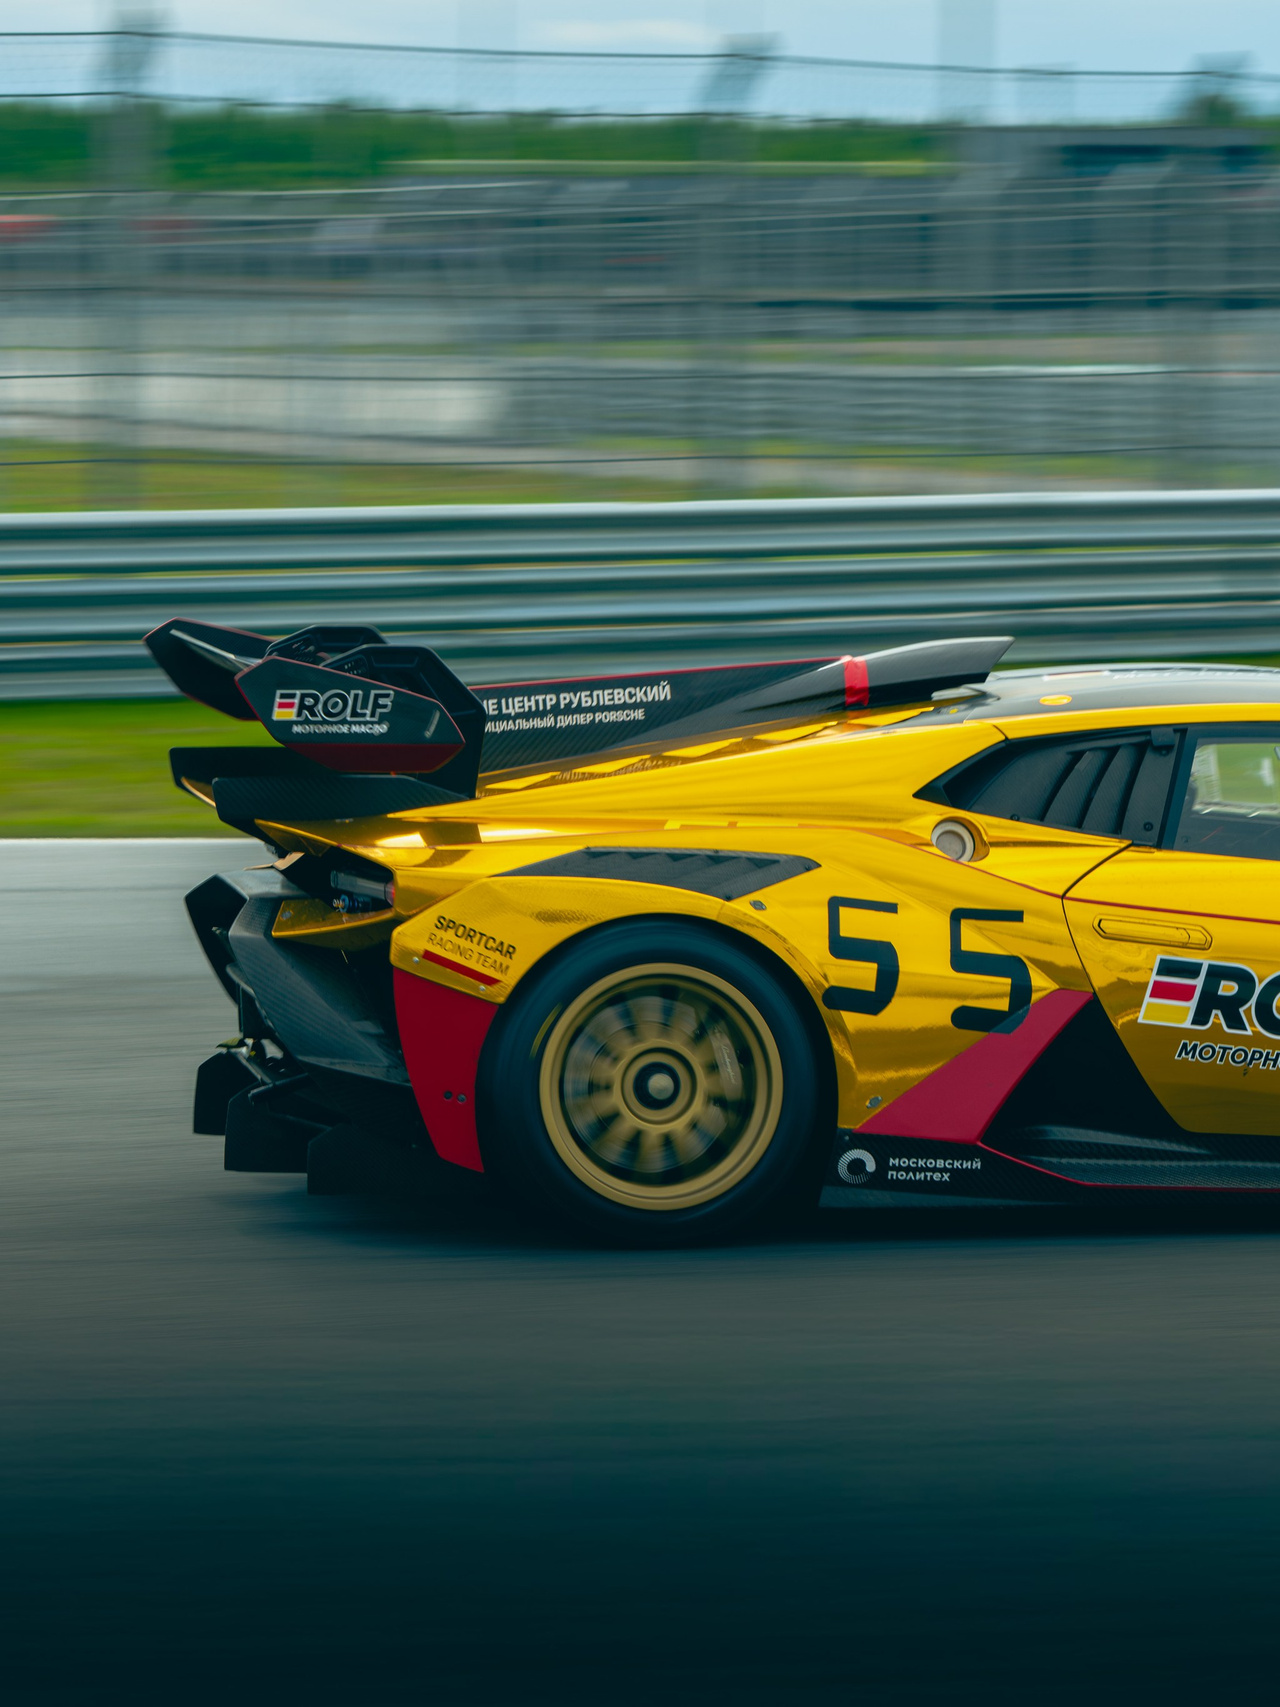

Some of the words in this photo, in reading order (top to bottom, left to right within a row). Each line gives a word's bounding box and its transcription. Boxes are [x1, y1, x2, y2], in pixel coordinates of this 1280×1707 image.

[295, 690, 395, 721] ROLF
[501, 694, 557, 716] ЦЕНТР
[559, 680, 672, 709] РУБЛЕВСКИЙ
[484, 714, 556, 734] ИЦИАЛЬНЫЙ
[556, 712, 593, 729] ДИЛЕР
[595, 708, 646, 724] PORSCHE
[427, 932, 474, 961] RACING
[475, 952, 510, 976] TEAM
[434, 915, 517, 960] SPORTCAR
